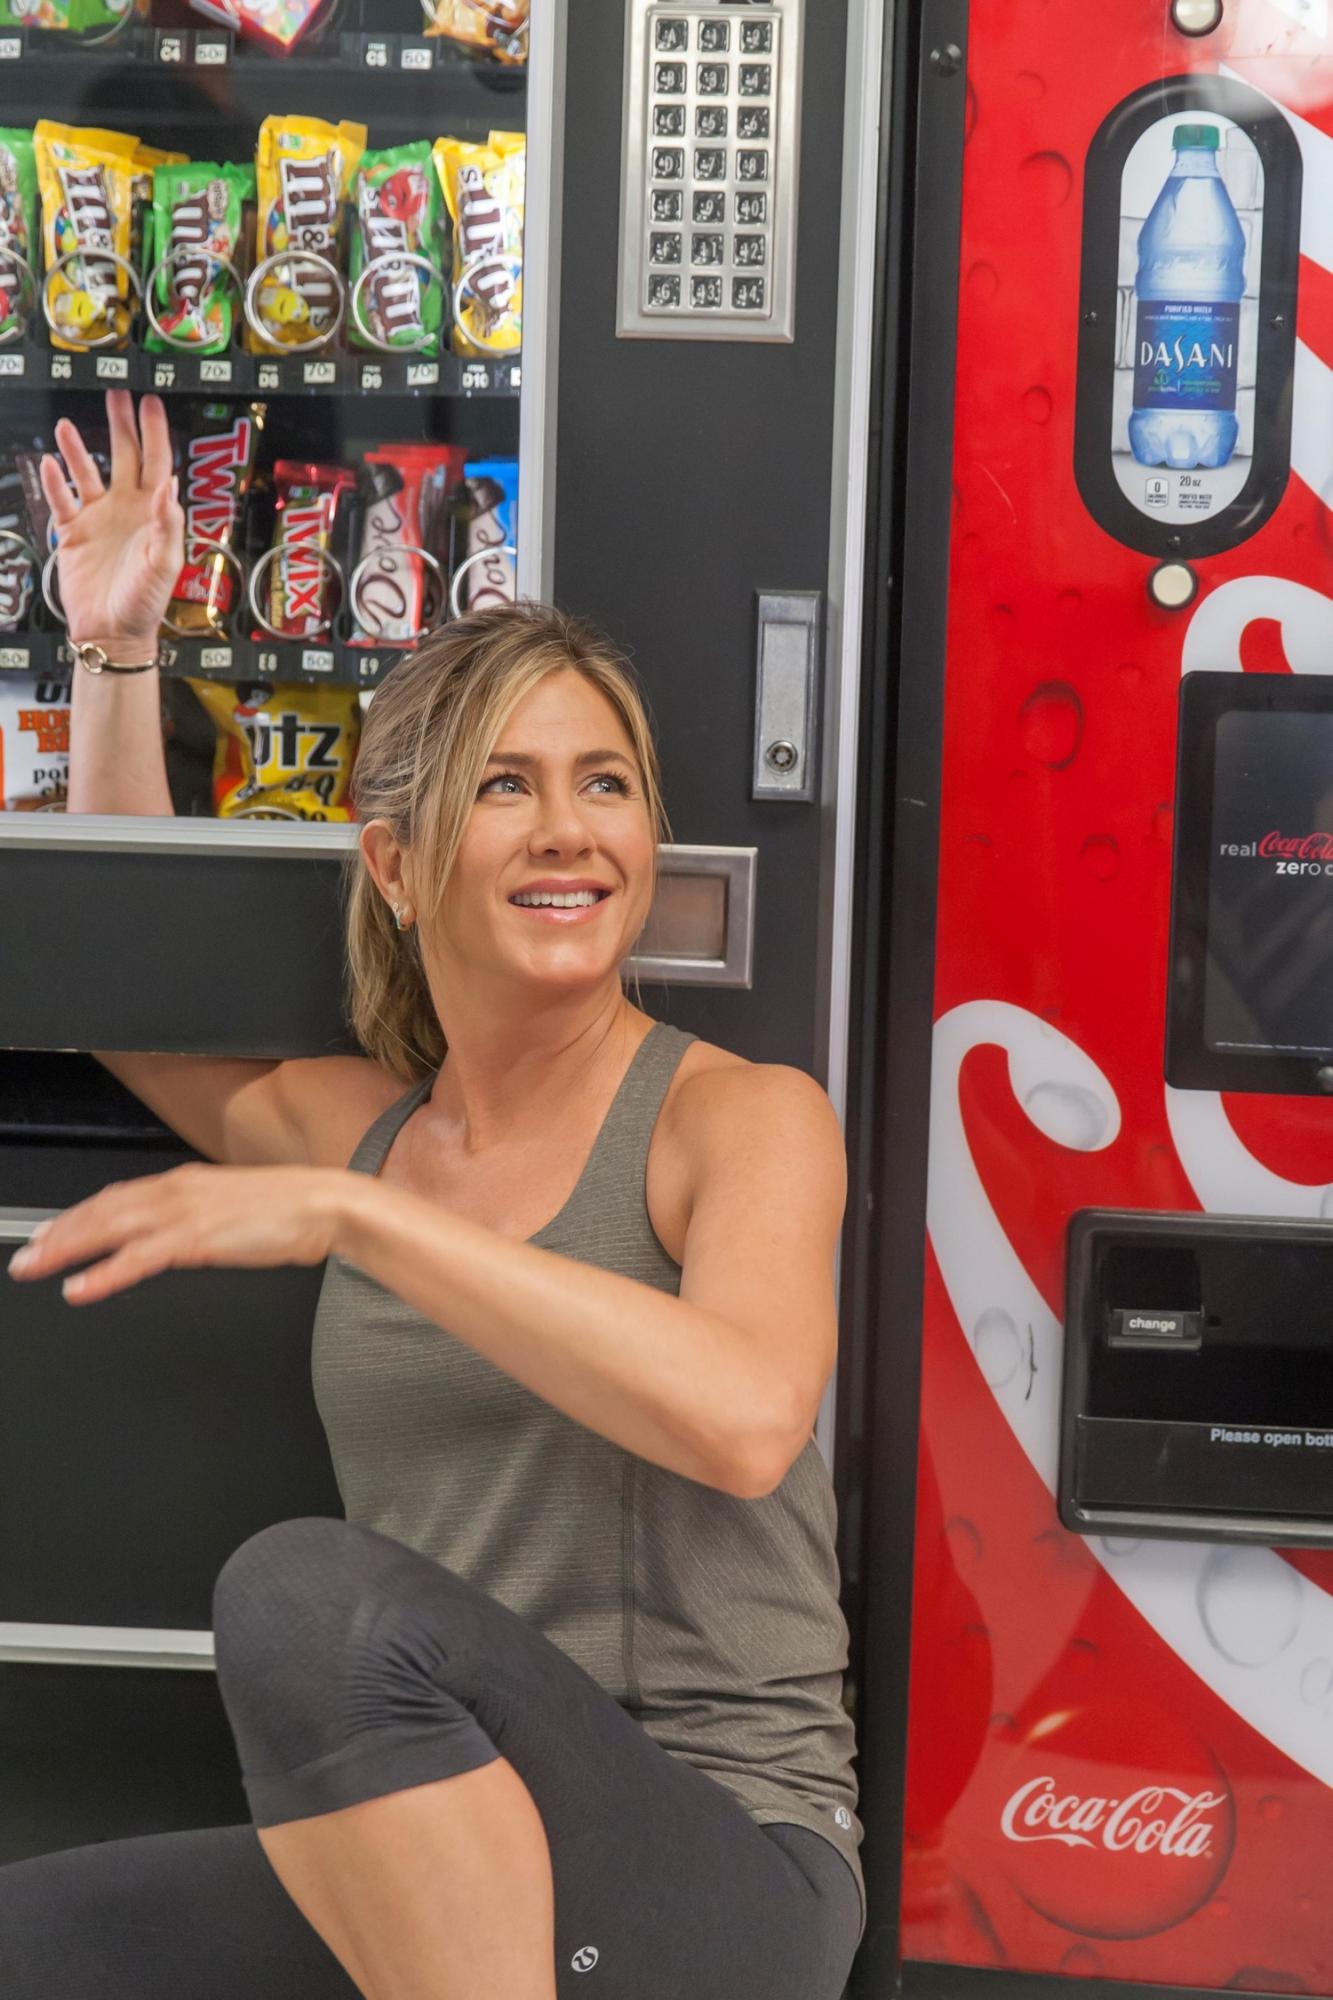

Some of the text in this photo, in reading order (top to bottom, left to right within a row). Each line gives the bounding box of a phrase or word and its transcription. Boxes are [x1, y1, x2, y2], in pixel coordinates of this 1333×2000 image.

[1140, 335, 1233, 374] DASANI
[154, 371, 175, 387] D7
[462, 372, 489, 388] D10
[1154, 481, 1161, 493] 0
[1180, 475, 1191, 487] 20
[356, 498, 407, 633] Dove
[258, 653, 278, 671] E8
[359, 657, 379, 675] E9
[1220, 841, 1256, 857] real
[1275, 861, 1322, 876] zero
[1129, 1316, 1176, 1333] change
[1210, 1428, 1261, 1443] Please
[1263, 1433, 1302, 1447] open
[1001, 1776, 1227, 1858] Coca-Cola
